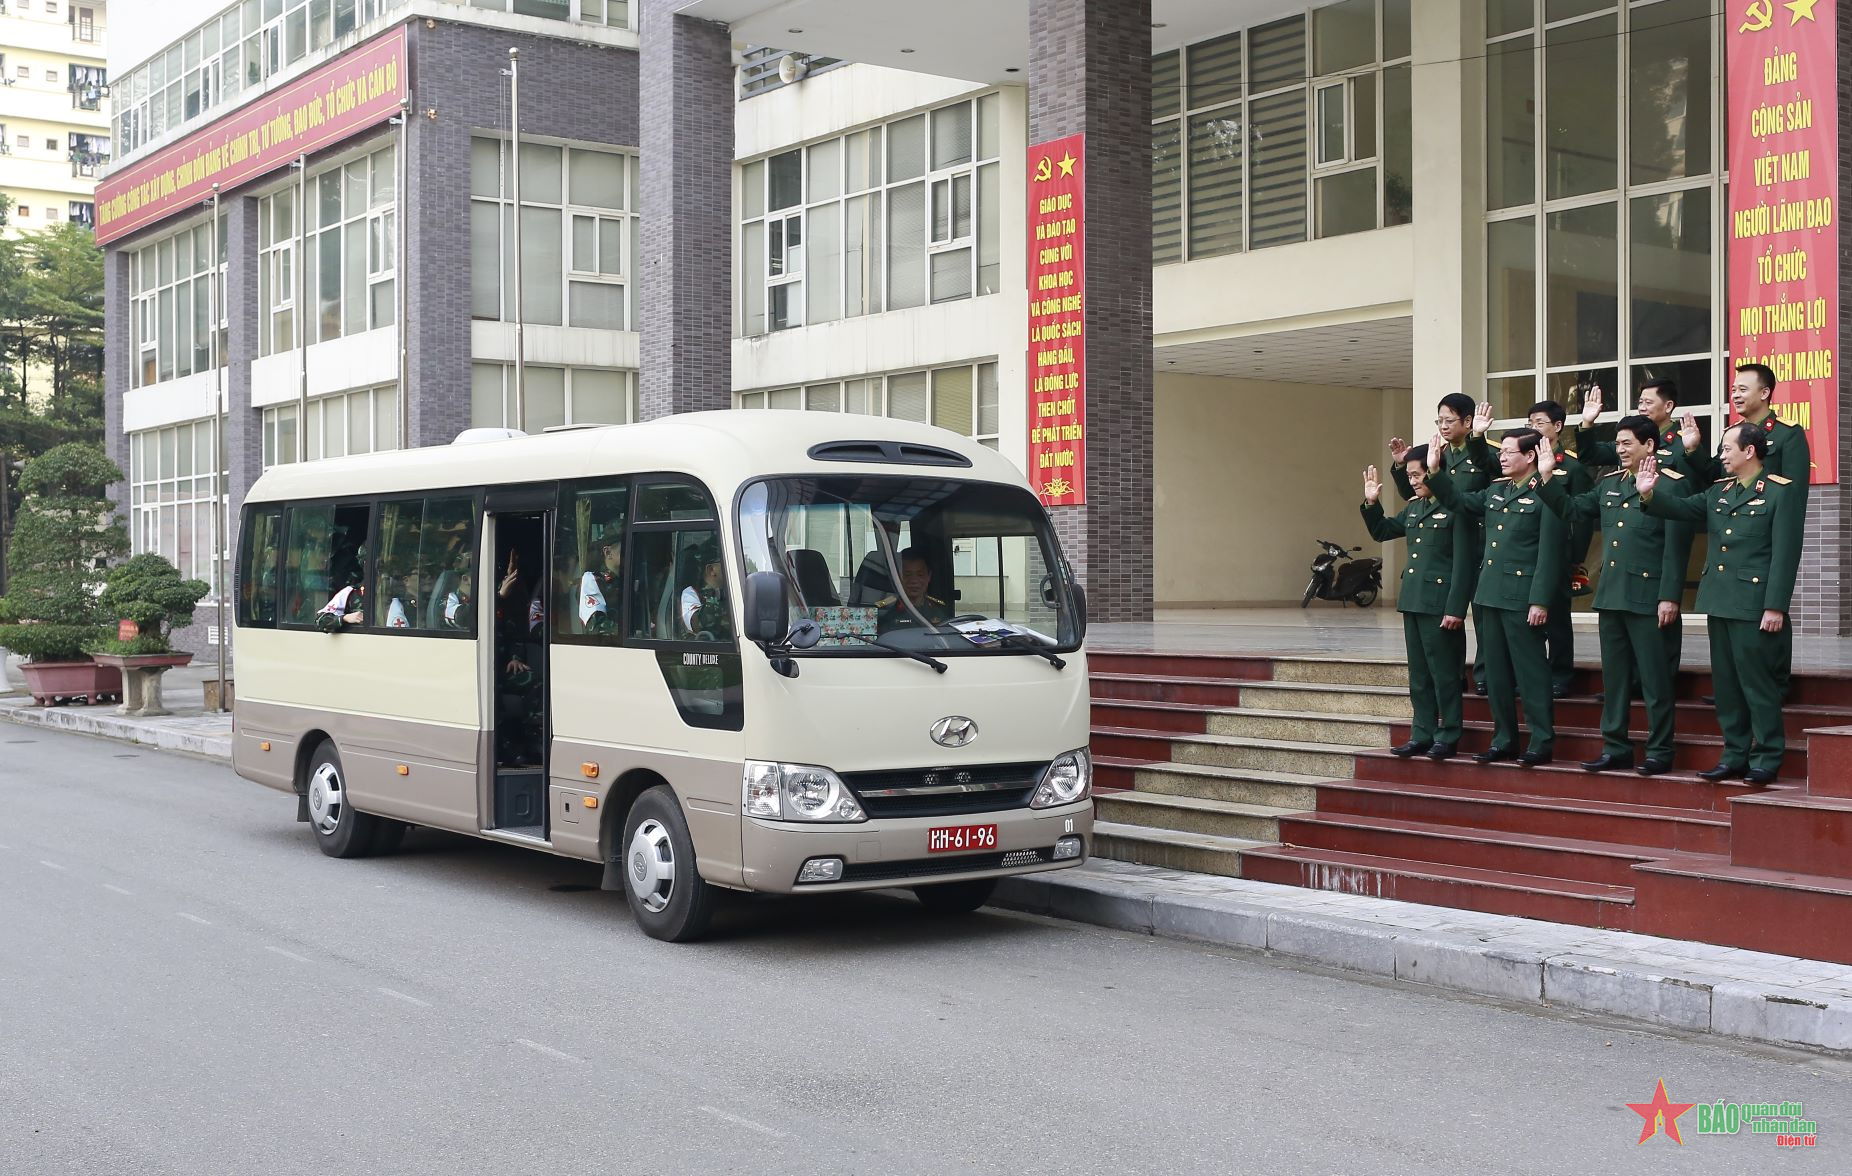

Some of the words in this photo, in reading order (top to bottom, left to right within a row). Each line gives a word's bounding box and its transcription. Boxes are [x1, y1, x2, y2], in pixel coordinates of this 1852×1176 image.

[1764, 46, 1797, 86] ĐẢNG
[230, 132, 248, 166] CHÍNH
[249, 128, 261, 160] TRỊ,
[261, 119, 270, 150] TƯ
[270, 106, 293, 146] TƯỞNG,
[294, 105, 308, 139] ĐẠO
[308, 91, 325, 126] ĐỨC,
[326, 80, 335, 121] TỔ
[336, 75, 356, 116] CHỨC
[356, 70, 367, 106] VÀ
[368, 63, 385, 101] CÁN
[386, 54, 397, 96] BỘ
[1752, 102, 1783, 142] CỘNG
[1786, 91, 1812, 132] SẢN
[1754, 152, 1779, 191] VIỆT
[1781, 150, 1810, 182] NAM
[1039, 194, 1056, 215] GIÁO
[1057, 193, 1073, 213] DỤC
[1036, 222, 1046, 241] VÀ
[1046, 219, 1061, 239] ĐÀO
[1062, 217, 1076, 238] TẠO
[1735, 200, 1770, 239] NGƯỜI
[1773, 198, 1804, 234] LÃNH
[1807, 196, 1832, 234] ĐẠO
[1039, 245, 1059, 266] CÙNG
[1060, 241, 1073, 261] VỚI
[1757, 244, 1772, 285] TỔ
[1775, 246, 1807, 283] CHỨC
[1038, 273, 1058, 291] KHOA
[1058, 270, 1074, 290] HỌC
[1031, 297, 1041, 318] VÀ
[1042, 295, 1061, 316] CÔNG
[1062, 291, 1082, 314] NGHỆ
[1740, 306, 1762, 341] MỌI
[1765, 293, 1804, 333] THẮNG
[1807, 297, 1826, 335] LỢI
[1031, 323, 1041, 343] LÀ
[1042, 319, 1061, 343] QUỐC
[1061, 318, 1082, 340] SÁCH
[1037, 348, 1057, 367] HÀNG
[1058, 343, 1075, 365] ĐẦU,
[1795, 349, 1832, 386] MẠNG
[1034, 374, 1044, 393] LÀ
[1044, 372, 1064, 394] ĐỘNG
[1064, 371, 1079, 391] LỰC
[1038, 402, 1056, 418] THEN
[1057, 393, 1076, 416] CHỐT
[1782, 401, 1810, 430] NAM
[1031, 421, 1042, 444] ĐỂ
[1042, 424, 1060, 443] PHÁT
[1061, 418, 1083, 441] TRIỂN
[1039, 447, 1054, 469] ĐẤT
[1054, 447, 1074, 468] NƯỚC
[683, 652, 701, 666] COUNTY
[1064, 818, 1073, 833] 01
